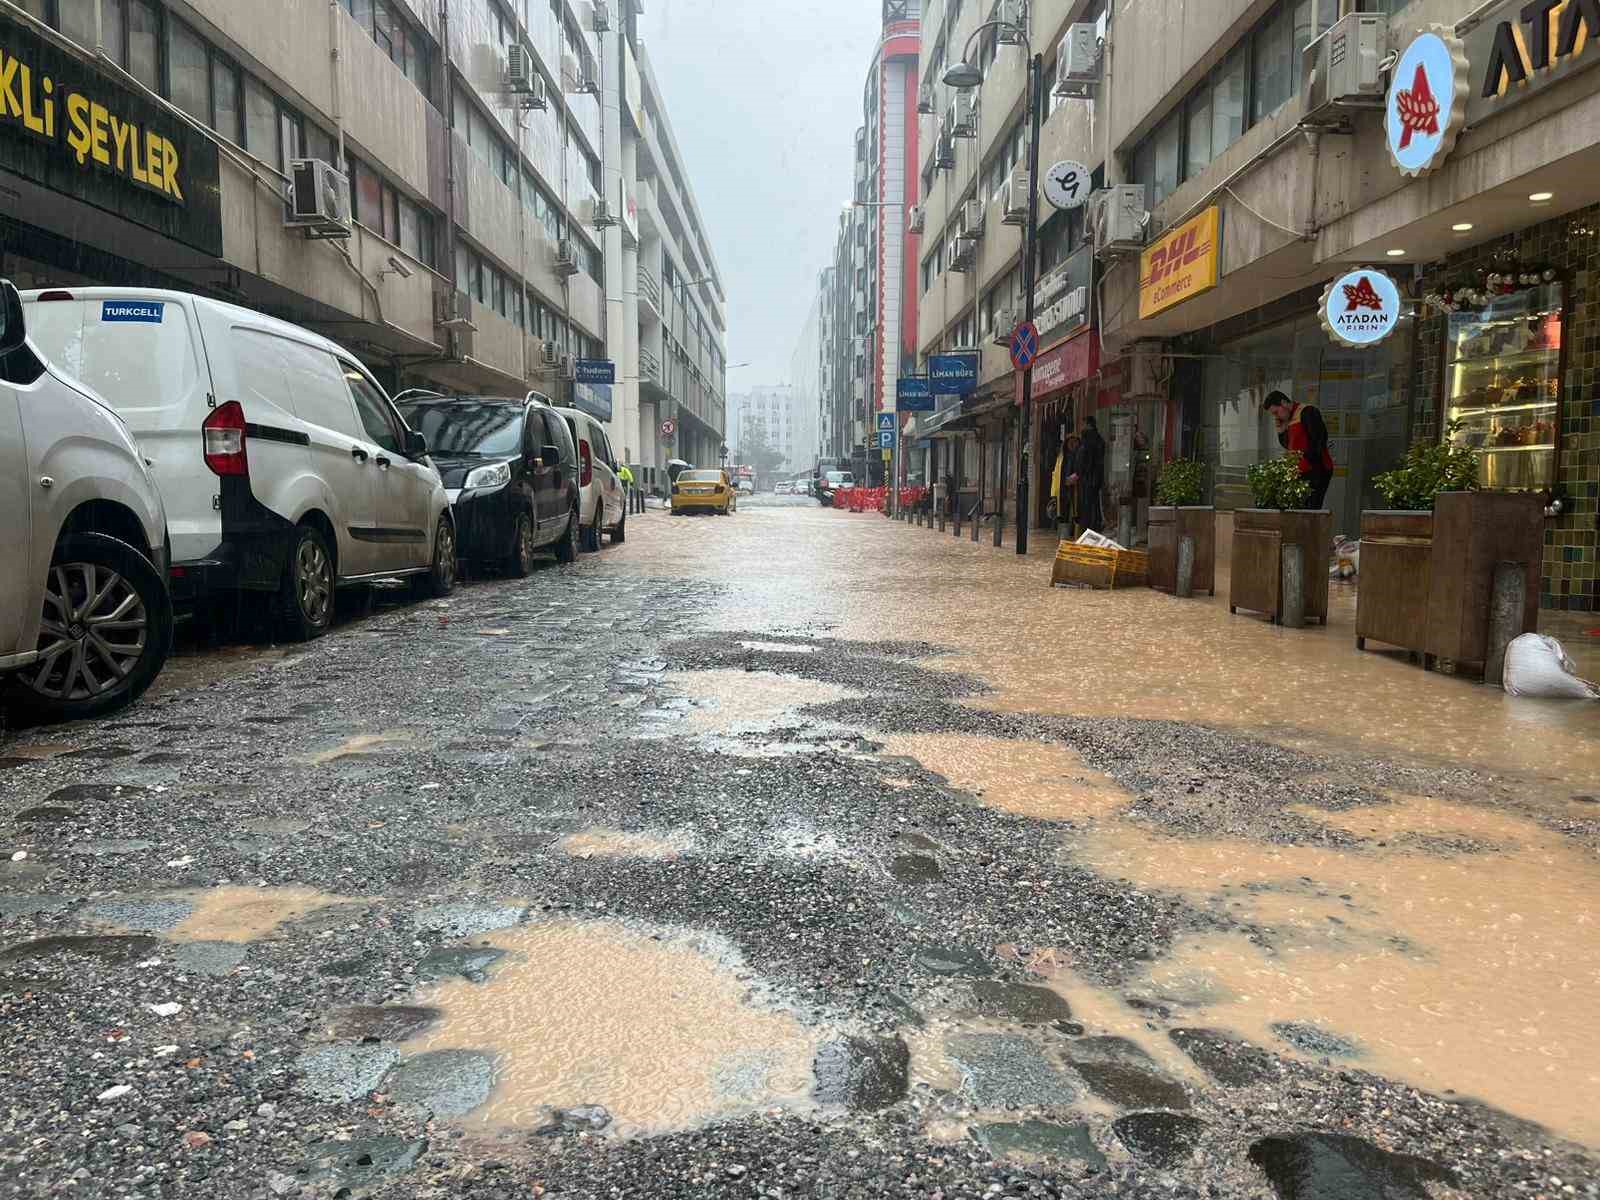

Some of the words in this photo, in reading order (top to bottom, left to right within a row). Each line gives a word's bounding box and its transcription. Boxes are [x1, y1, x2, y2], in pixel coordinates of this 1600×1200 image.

[66, 92, 183, 200] ŞEYLER
[1150, 227, 1201, 285] DHL
[105, 307, 160, 317] TURKCELL
[1337, 314, 1388, 324] ATADAN
